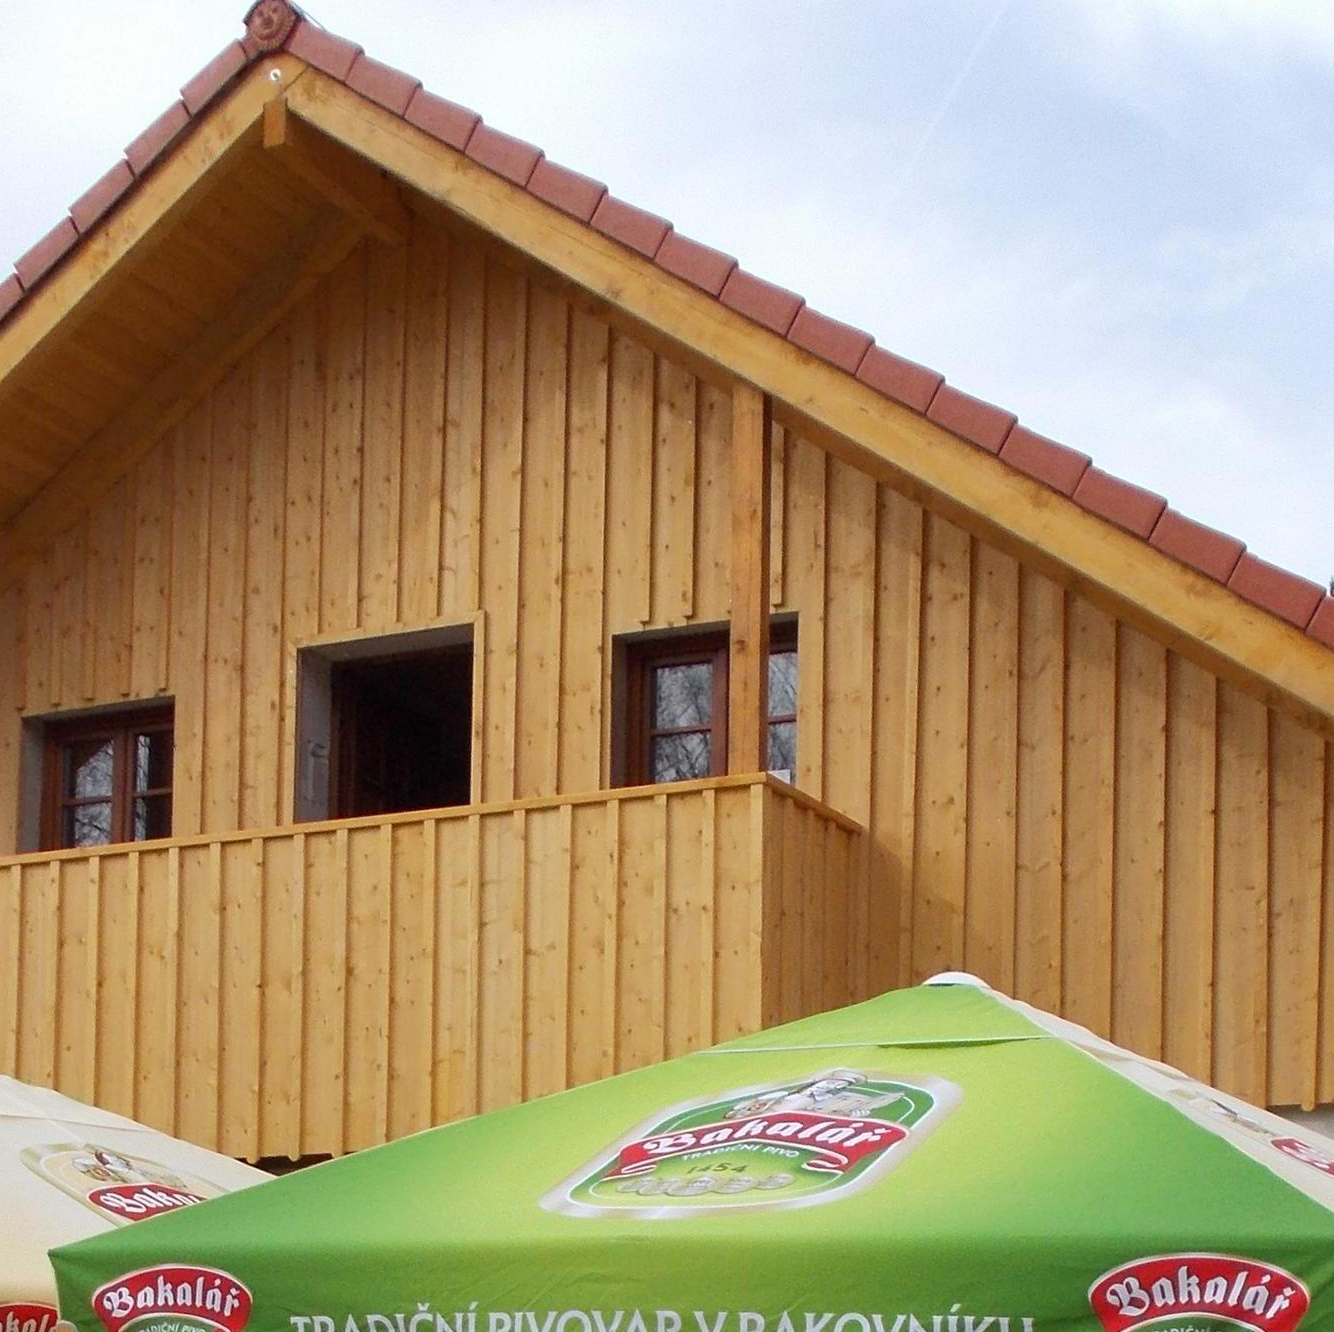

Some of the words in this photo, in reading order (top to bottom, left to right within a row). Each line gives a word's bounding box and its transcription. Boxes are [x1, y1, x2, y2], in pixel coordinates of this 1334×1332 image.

[642, 1118, 893, 1154] Bakalář
[763, 1146, 800, 1158] PIVO
[687, 1162, 749, 1174] 1454
[103, 1275, 242, 1318] Bakalář
[1105, 1265, 1296, 1319] Bakalář
